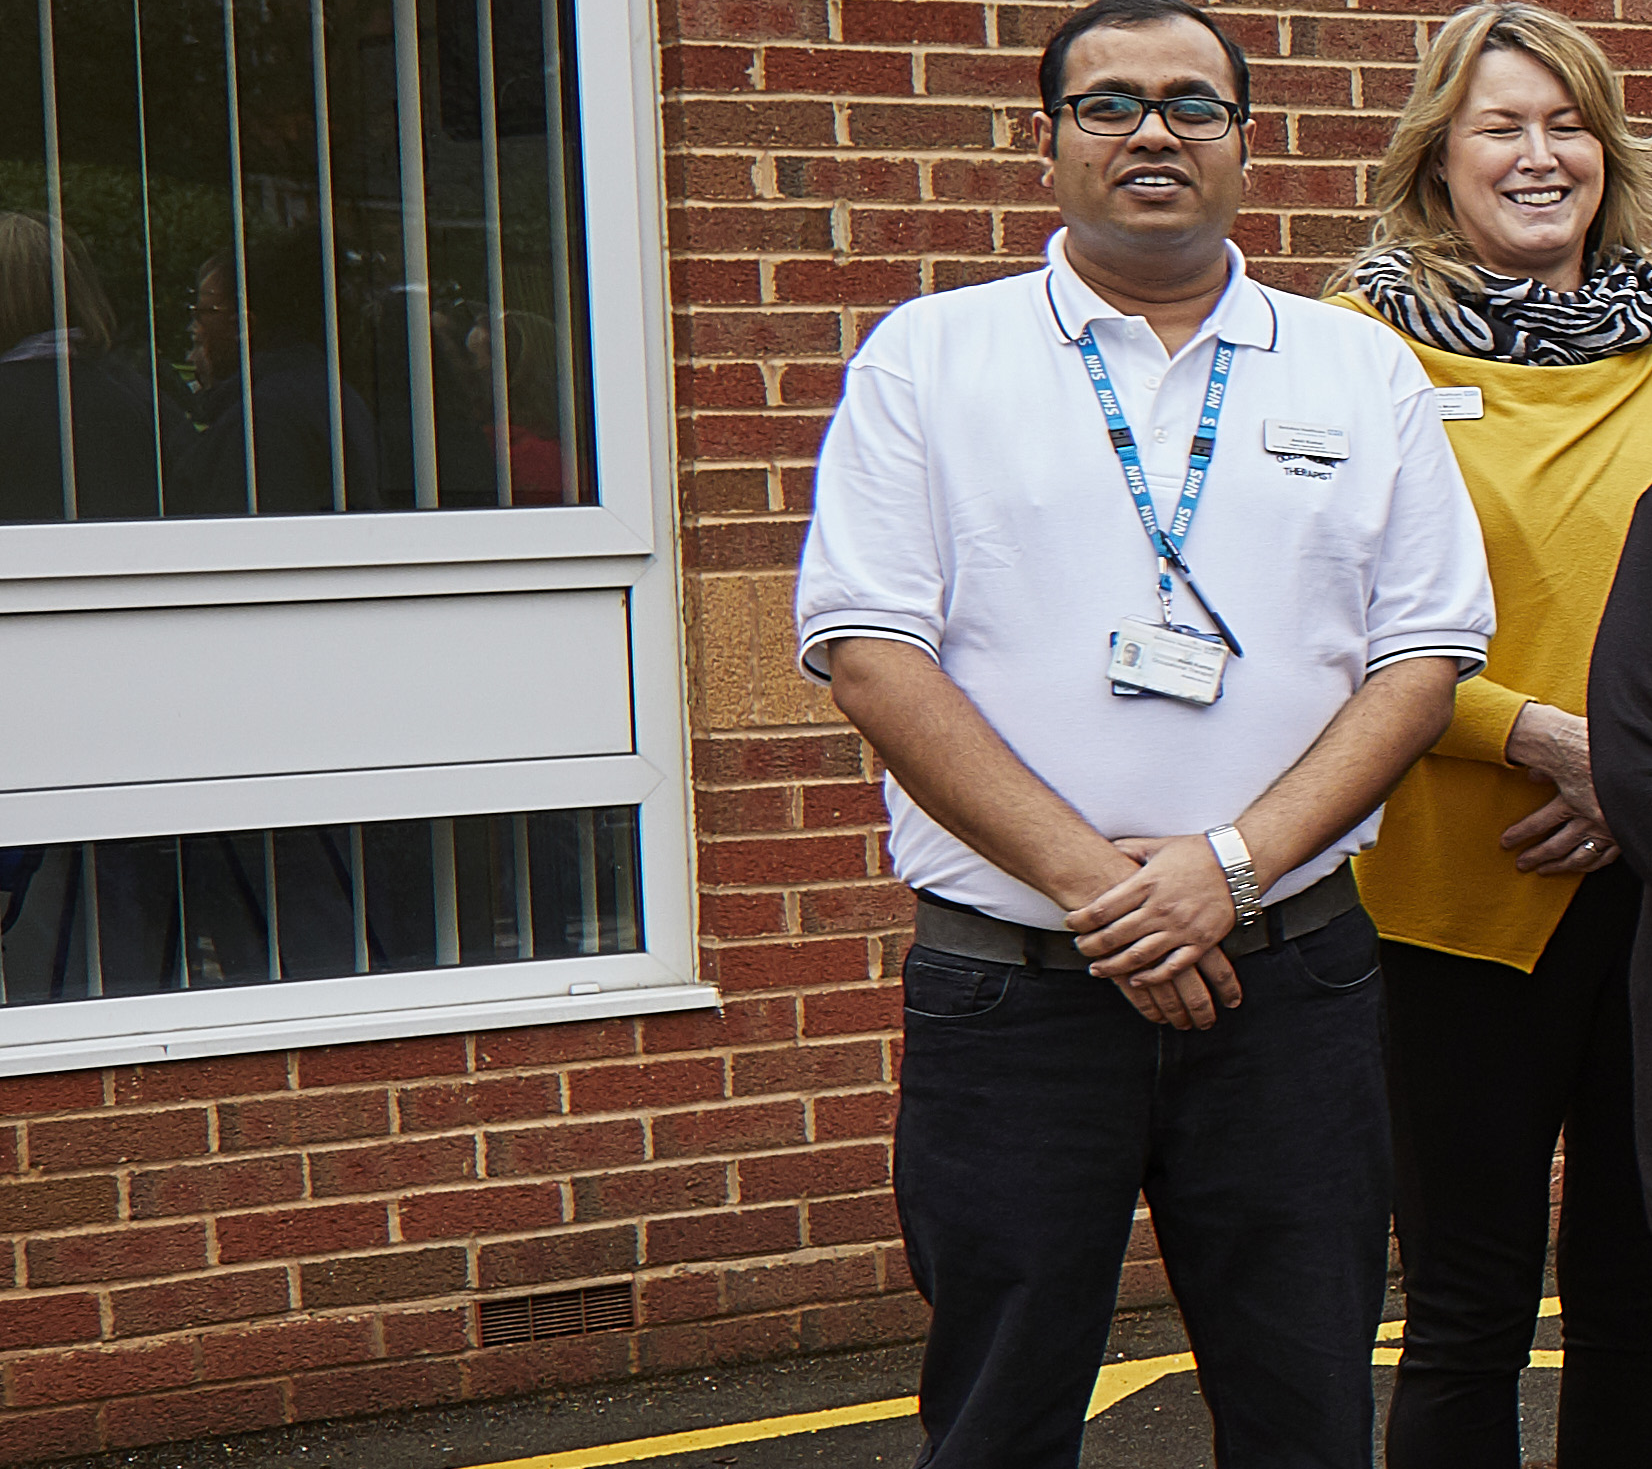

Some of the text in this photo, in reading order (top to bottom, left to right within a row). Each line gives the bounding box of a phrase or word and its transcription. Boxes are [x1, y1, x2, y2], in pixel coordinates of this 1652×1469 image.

[1085, 354, 1106, 380] NHS
[1215, 347, 1232, 374] NHS
[1098, 389, 1119, 416] NHS
[1206, 381, 1224, 409] NHS
[1125, 465, 1146, 495] NHS
[1184, 468, 1204, 498] NHS
[1172, 506, 1192, 536] NHS
